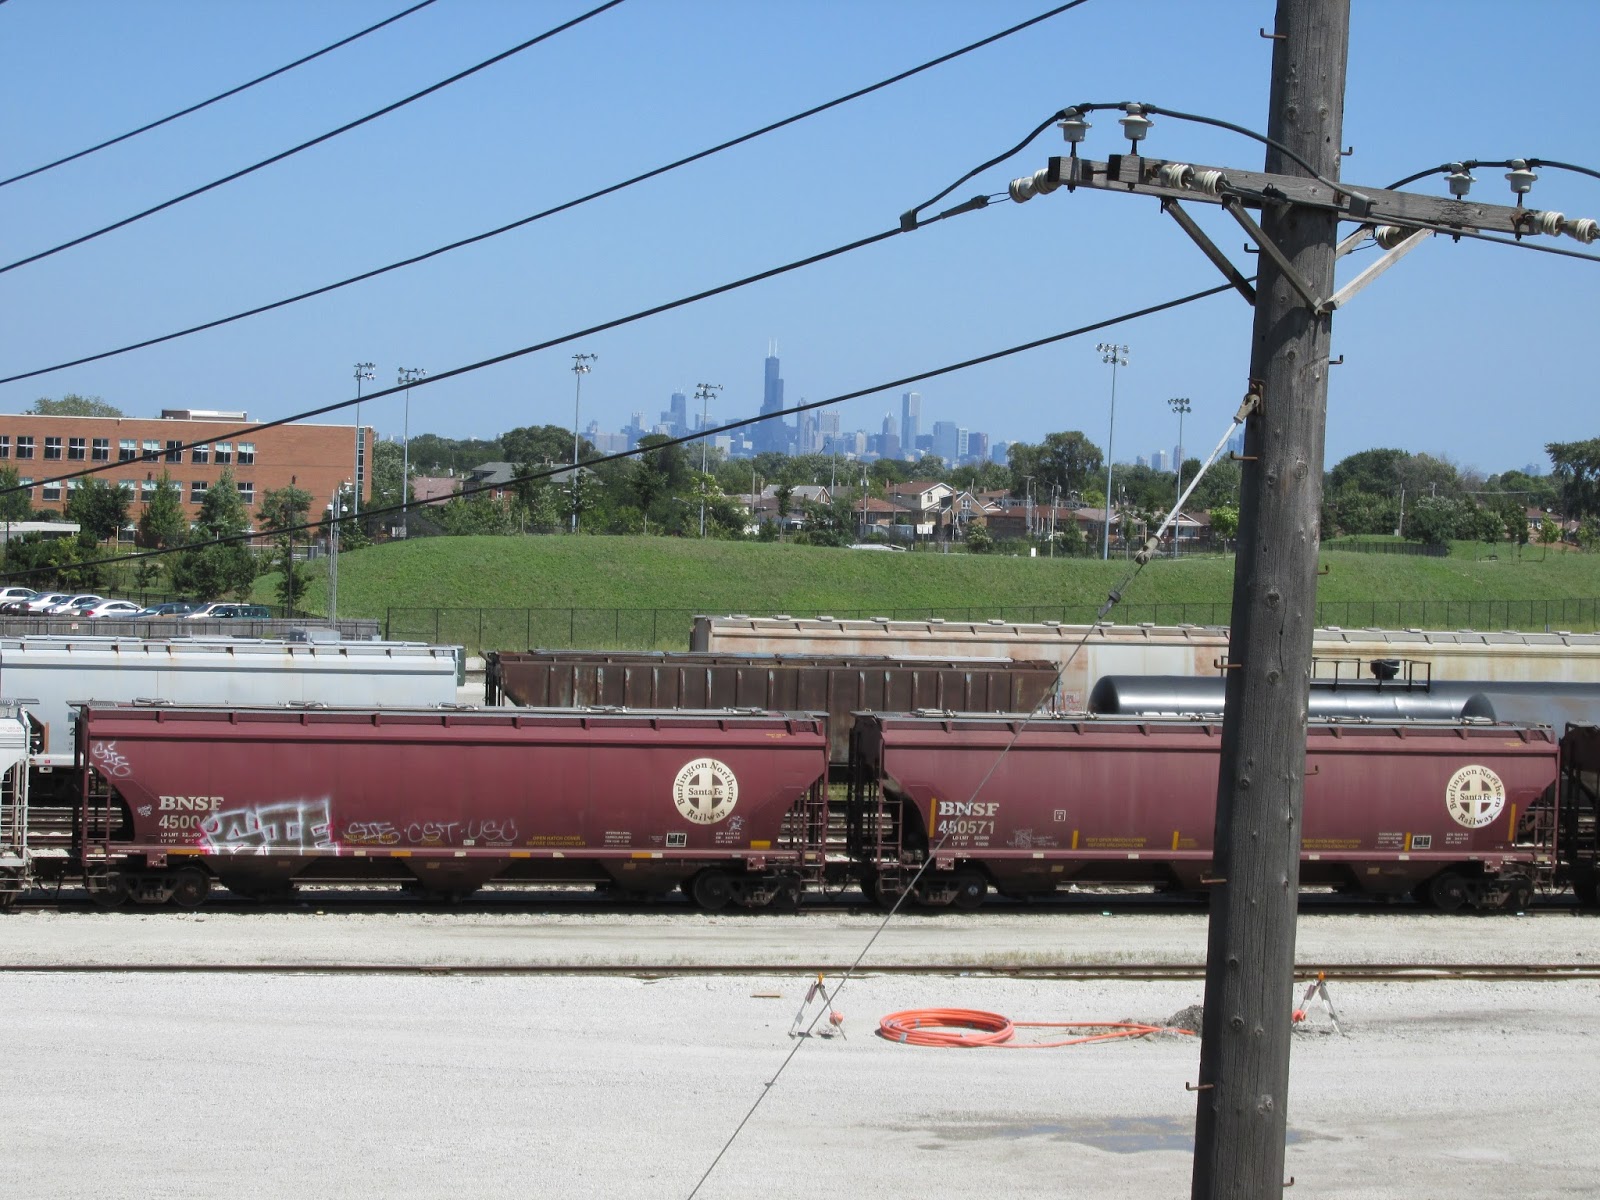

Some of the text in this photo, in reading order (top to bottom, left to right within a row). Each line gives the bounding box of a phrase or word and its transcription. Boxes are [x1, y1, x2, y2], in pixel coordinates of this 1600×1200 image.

[676, 761, 735, 806] Burlington Northern
[1449, 768, 1502, 811] Burlington Northern
[688, 787, 723, 796] Santa Fe
[1460, 792, 1492, 801] Santa Fe
[158, 795, 225, 811] BNSF
[938, 801, 1000, 817] BNSF
[686, 809, 726, 822] Railway
[1458, 813, 1494, 826] Railway
[938, 820, 995, 835] 450571
